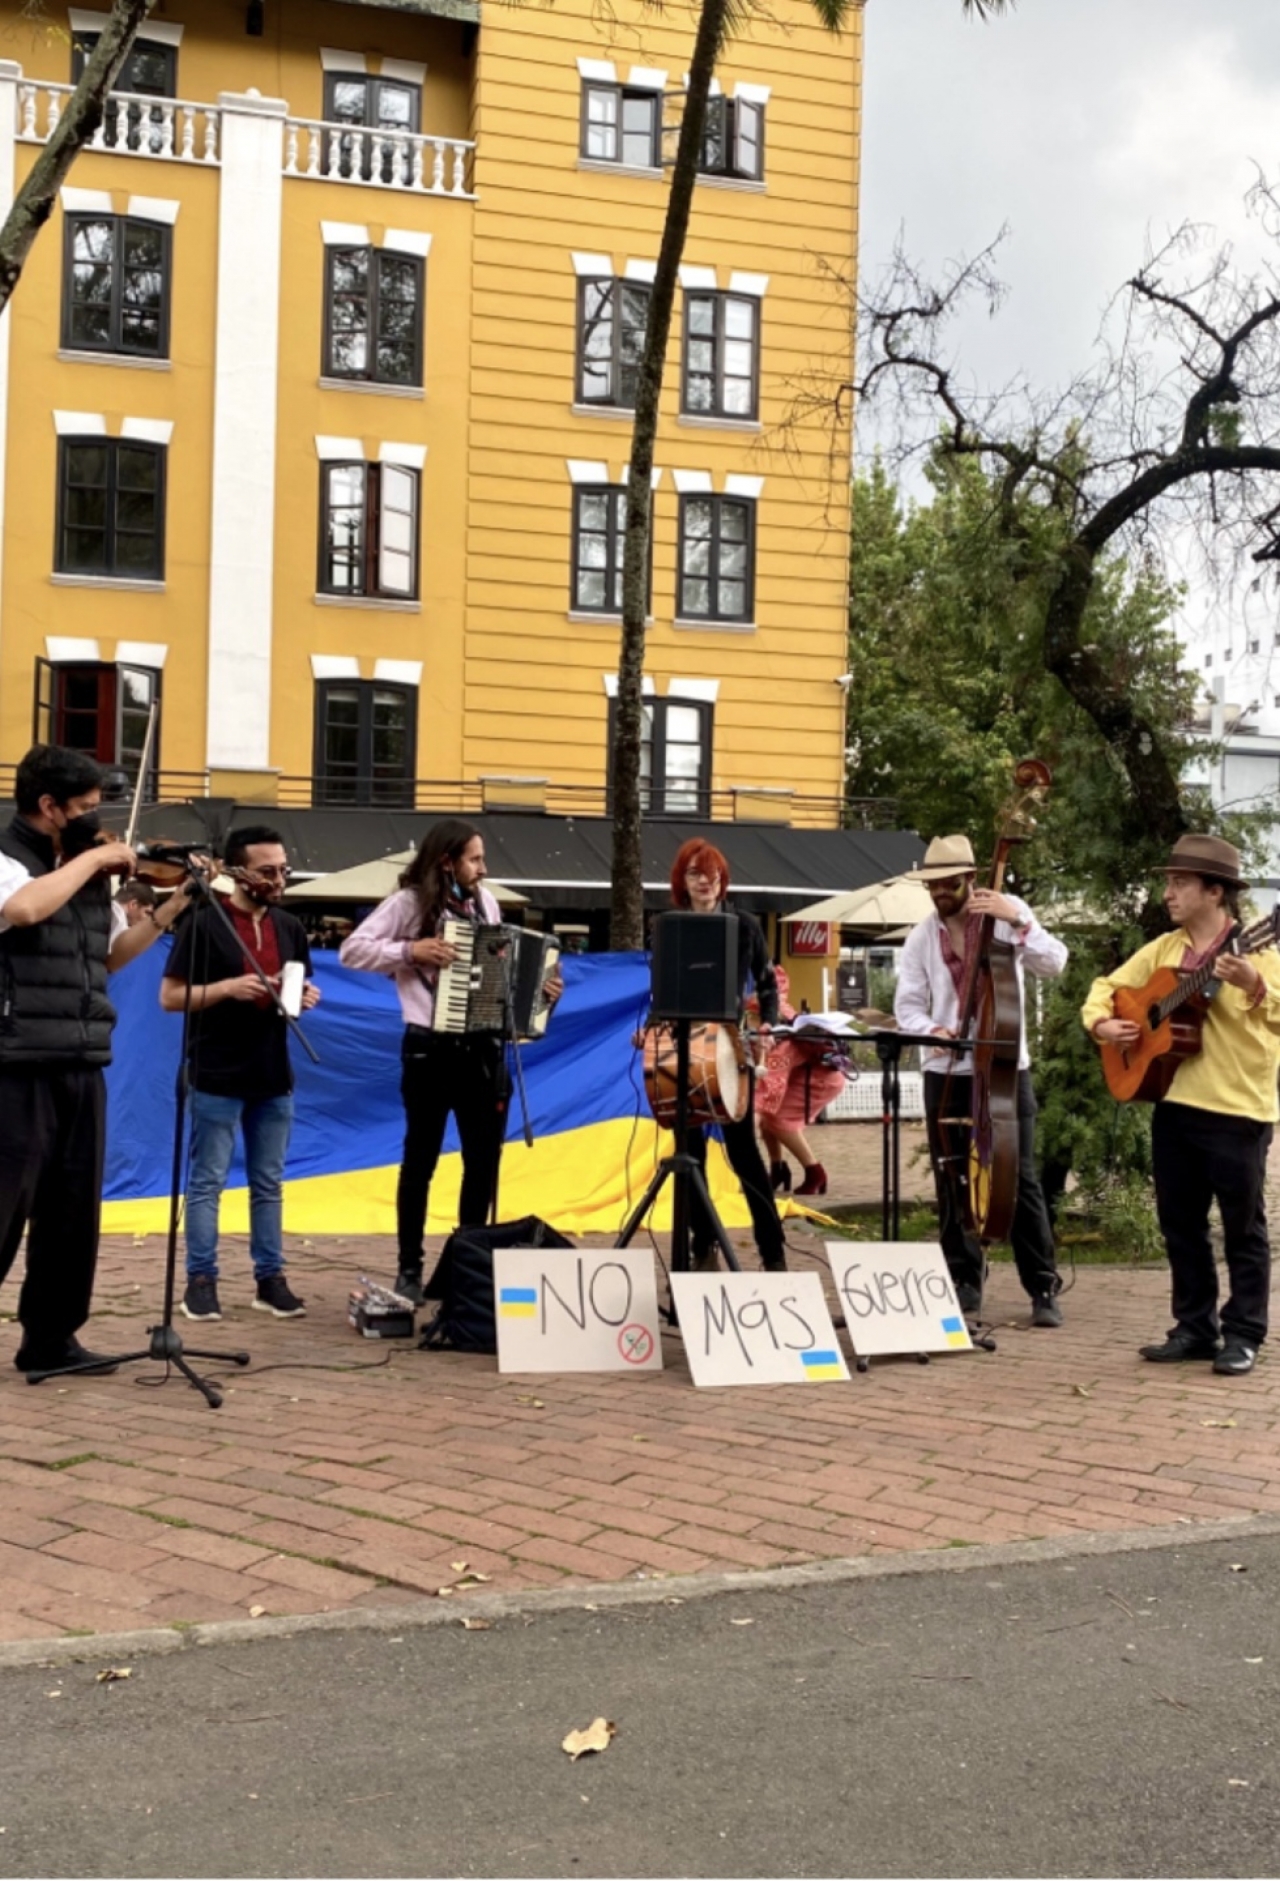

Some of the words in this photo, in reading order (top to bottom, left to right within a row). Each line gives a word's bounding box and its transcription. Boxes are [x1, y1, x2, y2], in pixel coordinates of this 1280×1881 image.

[794, 920, 828, 950] illy
[541, 1258, 632, 1335] NO
[842, 1263, 955, 1319] Guerra
[703, 1284, 816, 1368] Más
